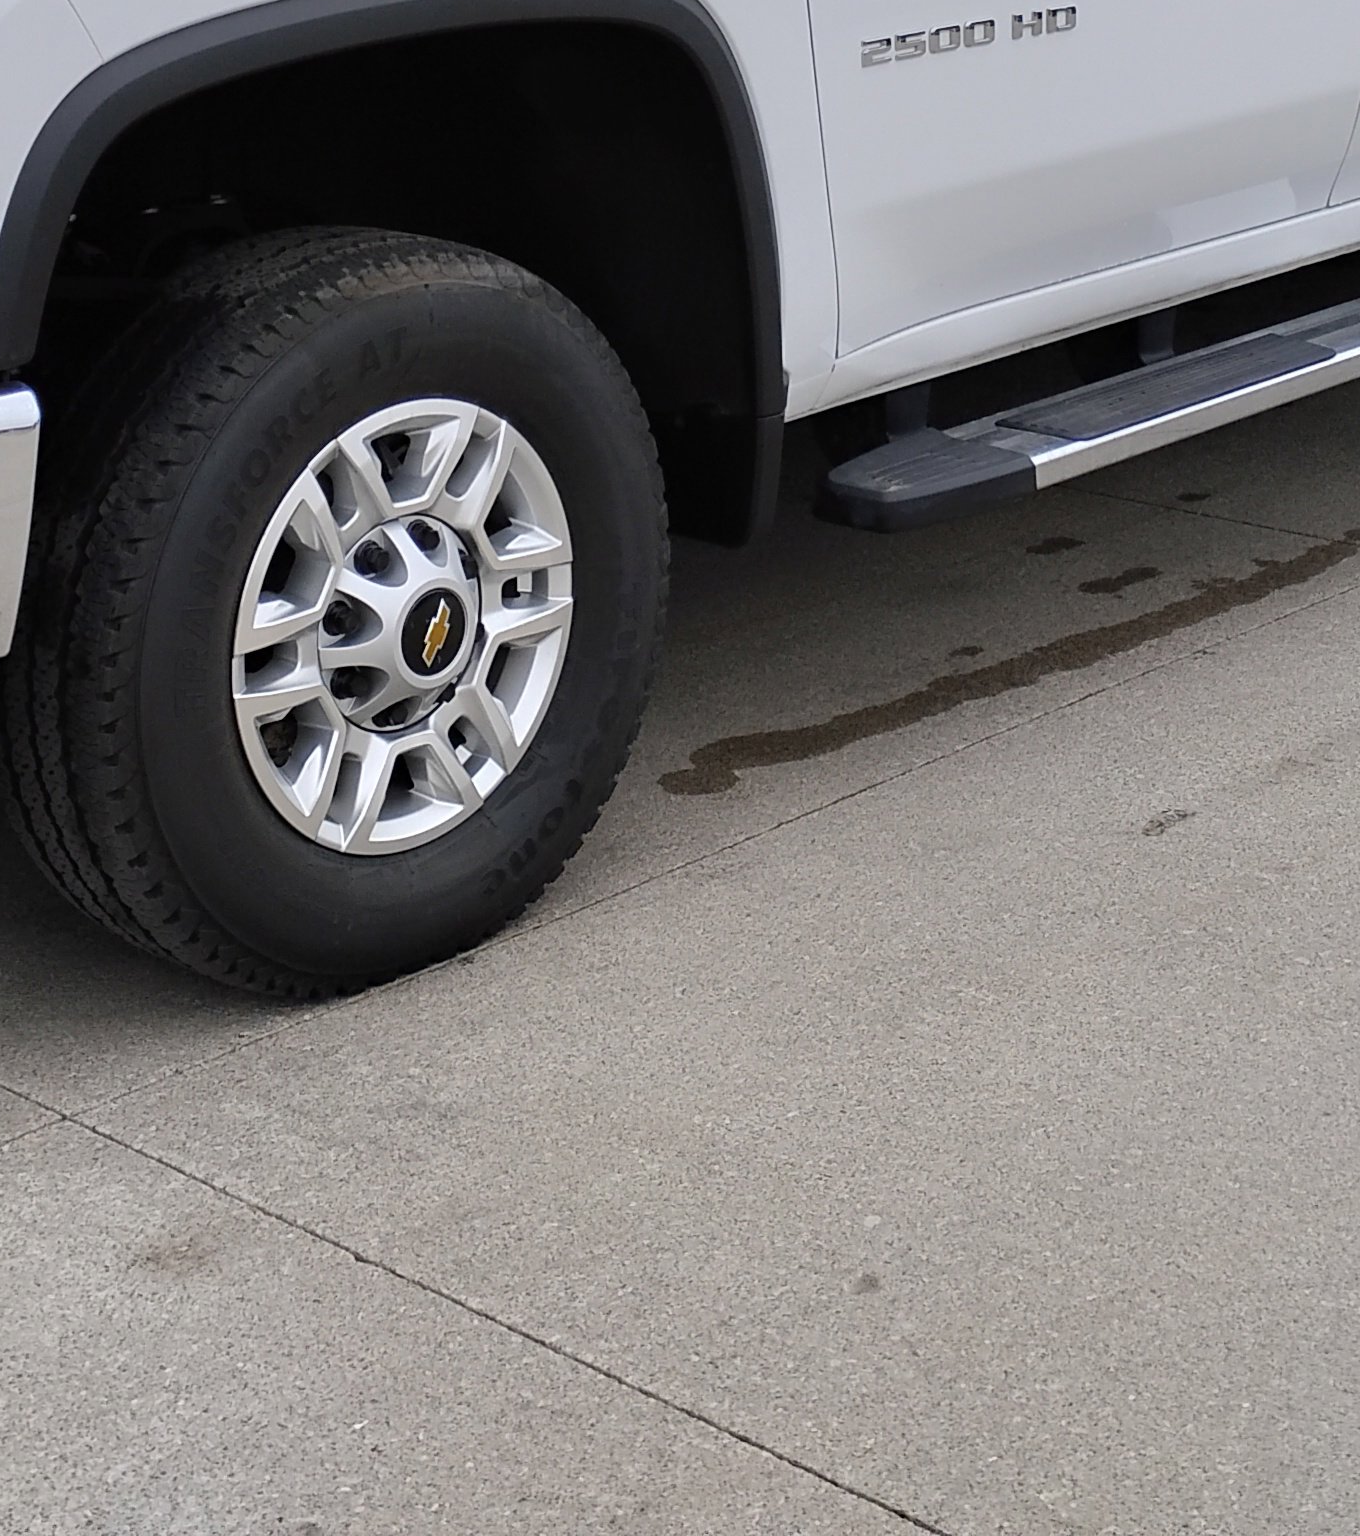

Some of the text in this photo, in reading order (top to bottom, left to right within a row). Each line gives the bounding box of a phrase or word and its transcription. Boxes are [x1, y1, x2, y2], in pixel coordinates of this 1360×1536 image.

[860, 5, 1077, 68] 2500 HD
[358, 326, 408, 381] AT
